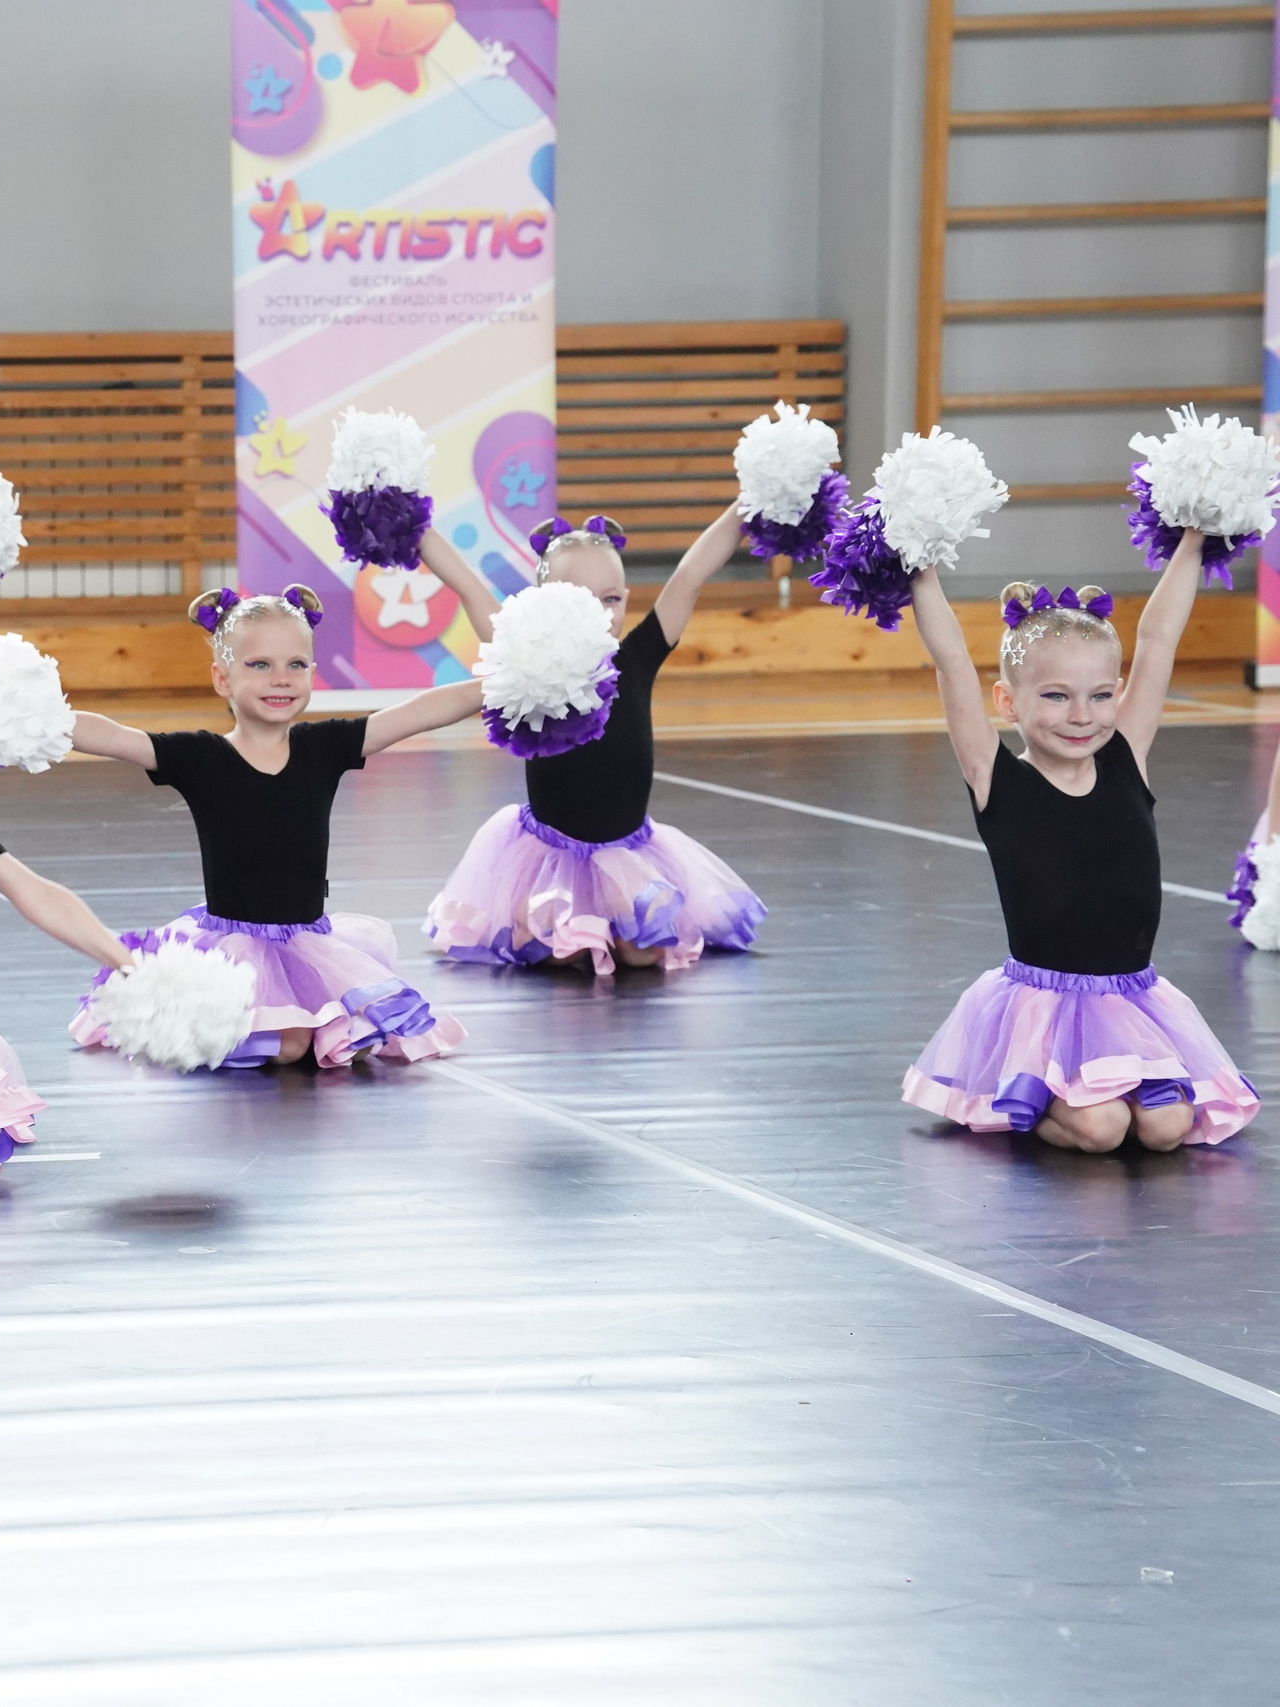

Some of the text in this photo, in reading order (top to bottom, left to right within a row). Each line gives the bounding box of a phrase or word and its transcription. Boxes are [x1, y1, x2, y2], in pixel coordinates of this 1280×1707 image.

[249, 178, 546, 262] ARTISTIC
[349, 275, 447, 287] ФЕСТИВАЛЬ
[264, 292, 533, 307] ЭСТЕТИЧЕСКИХ ВИДОВ СПОРТА И
[257, 311, 539, 327] ХОРЕОГРАФИЧЕСКОГО ИСКУССТВА
